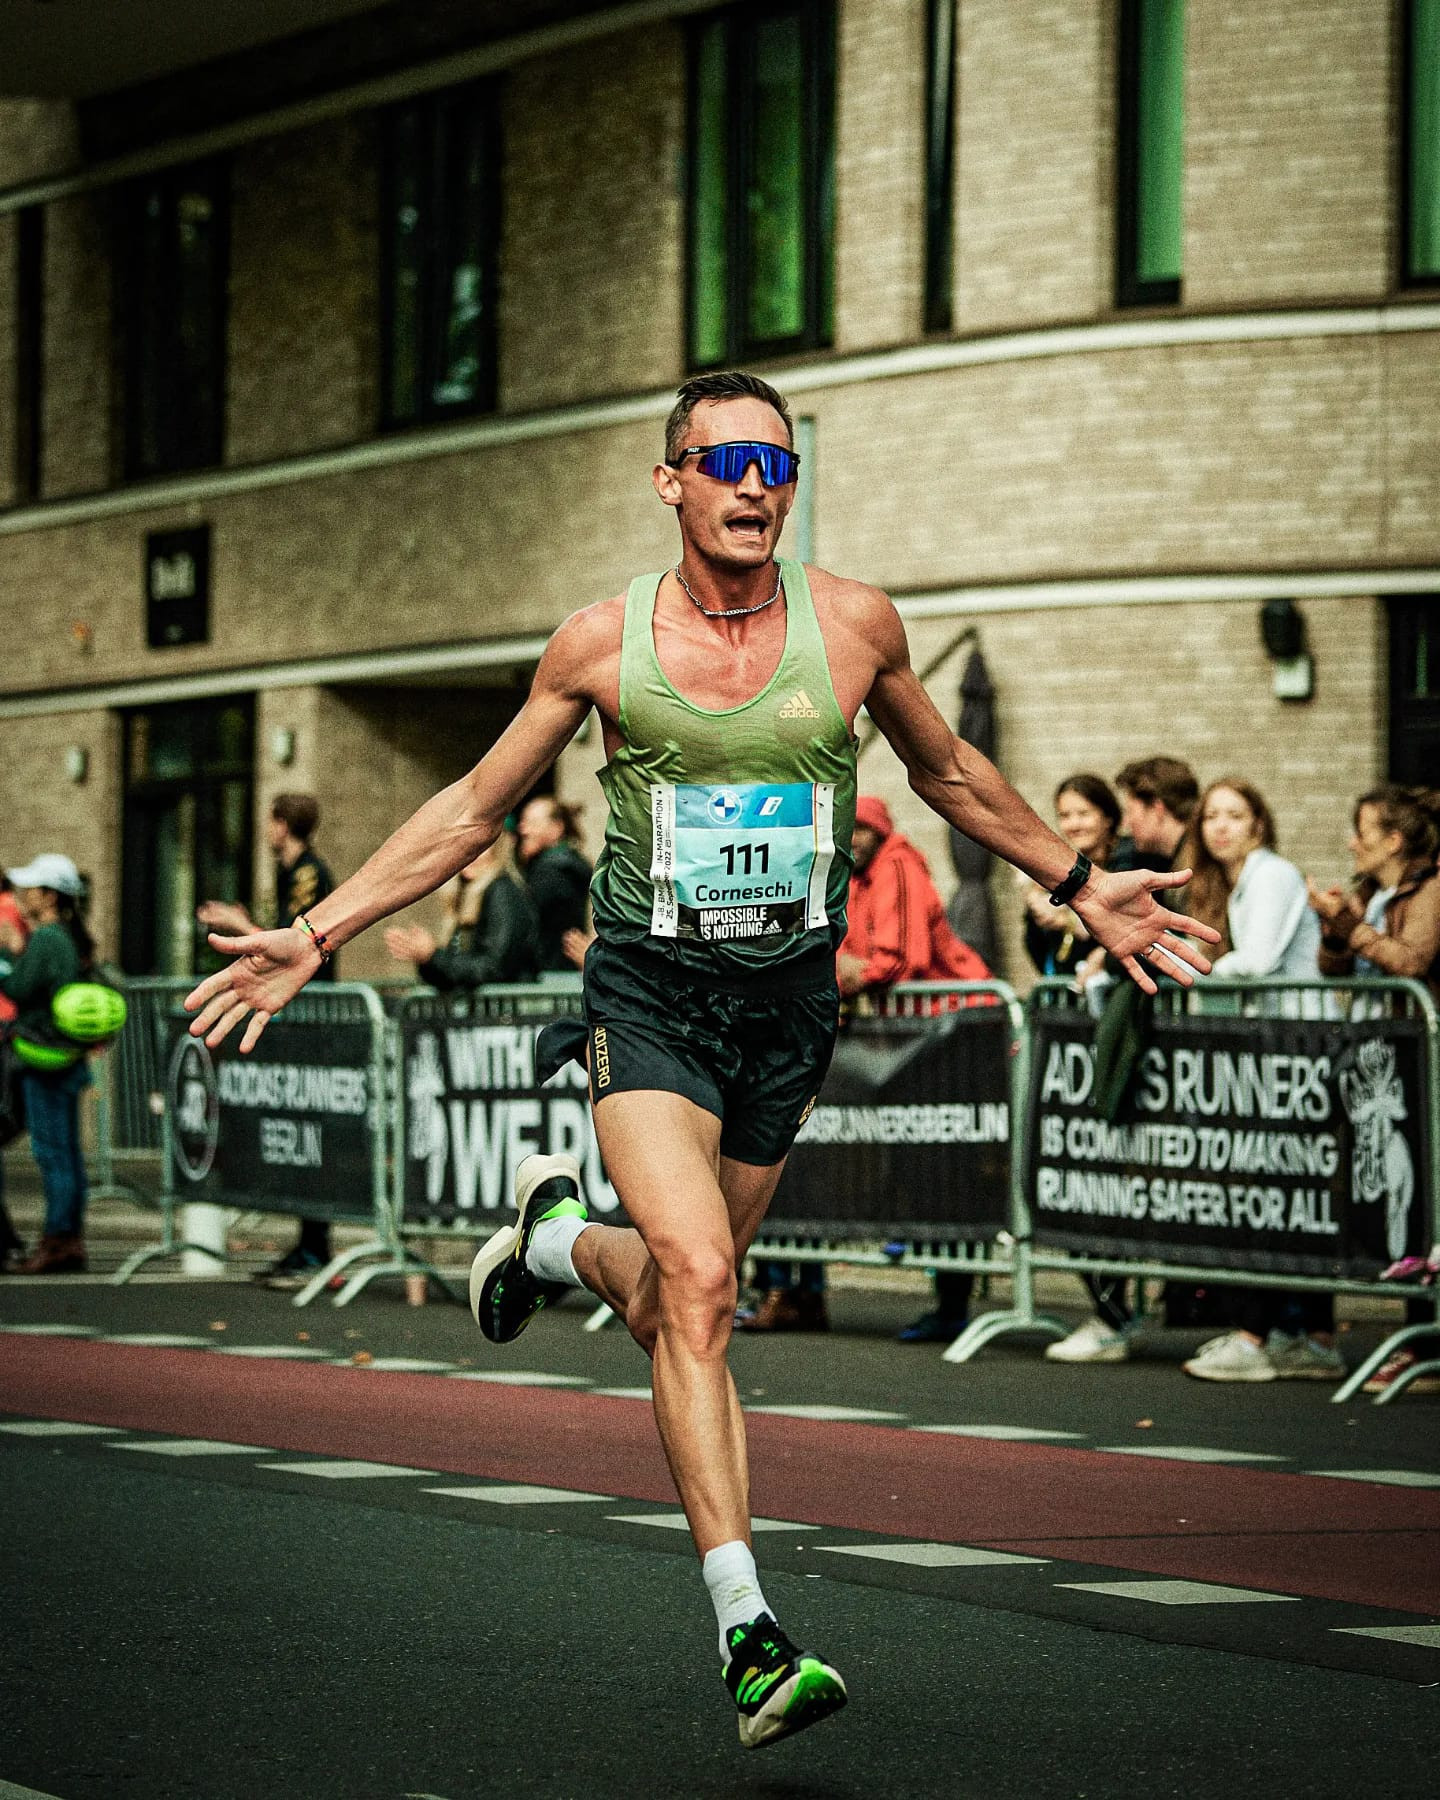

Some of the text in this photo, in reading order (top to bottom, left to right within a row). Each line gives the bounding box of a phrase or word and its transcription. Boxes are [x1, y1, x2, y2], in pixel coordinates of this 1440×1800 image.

[779, 708, 820, 718] adidas
[664, 851, 672, 871] 2022
[719, 842, 769, 875] 111
[695, 881, 793, 902] Corneschi
[665, 908, 674, 919] 25.
[700, 906, 767, 926] IMPOSSIBLE
[700, 921, 763, 940] IS NOTHING
[447, 1025, 534, 1090] WITH
[594, 1025, 611, 1088] ADIZERO
[1173, 1049, 1332, 1121] RUNNERS
[1040, 1115, 1065, 1158] IS
[1197, 1127, 1231, 1172] TO
[1230, 1129, 1339, 1178] MAKING
[1036, 1165, 1340, 1235] RUNNING SAFER FOR ALL
